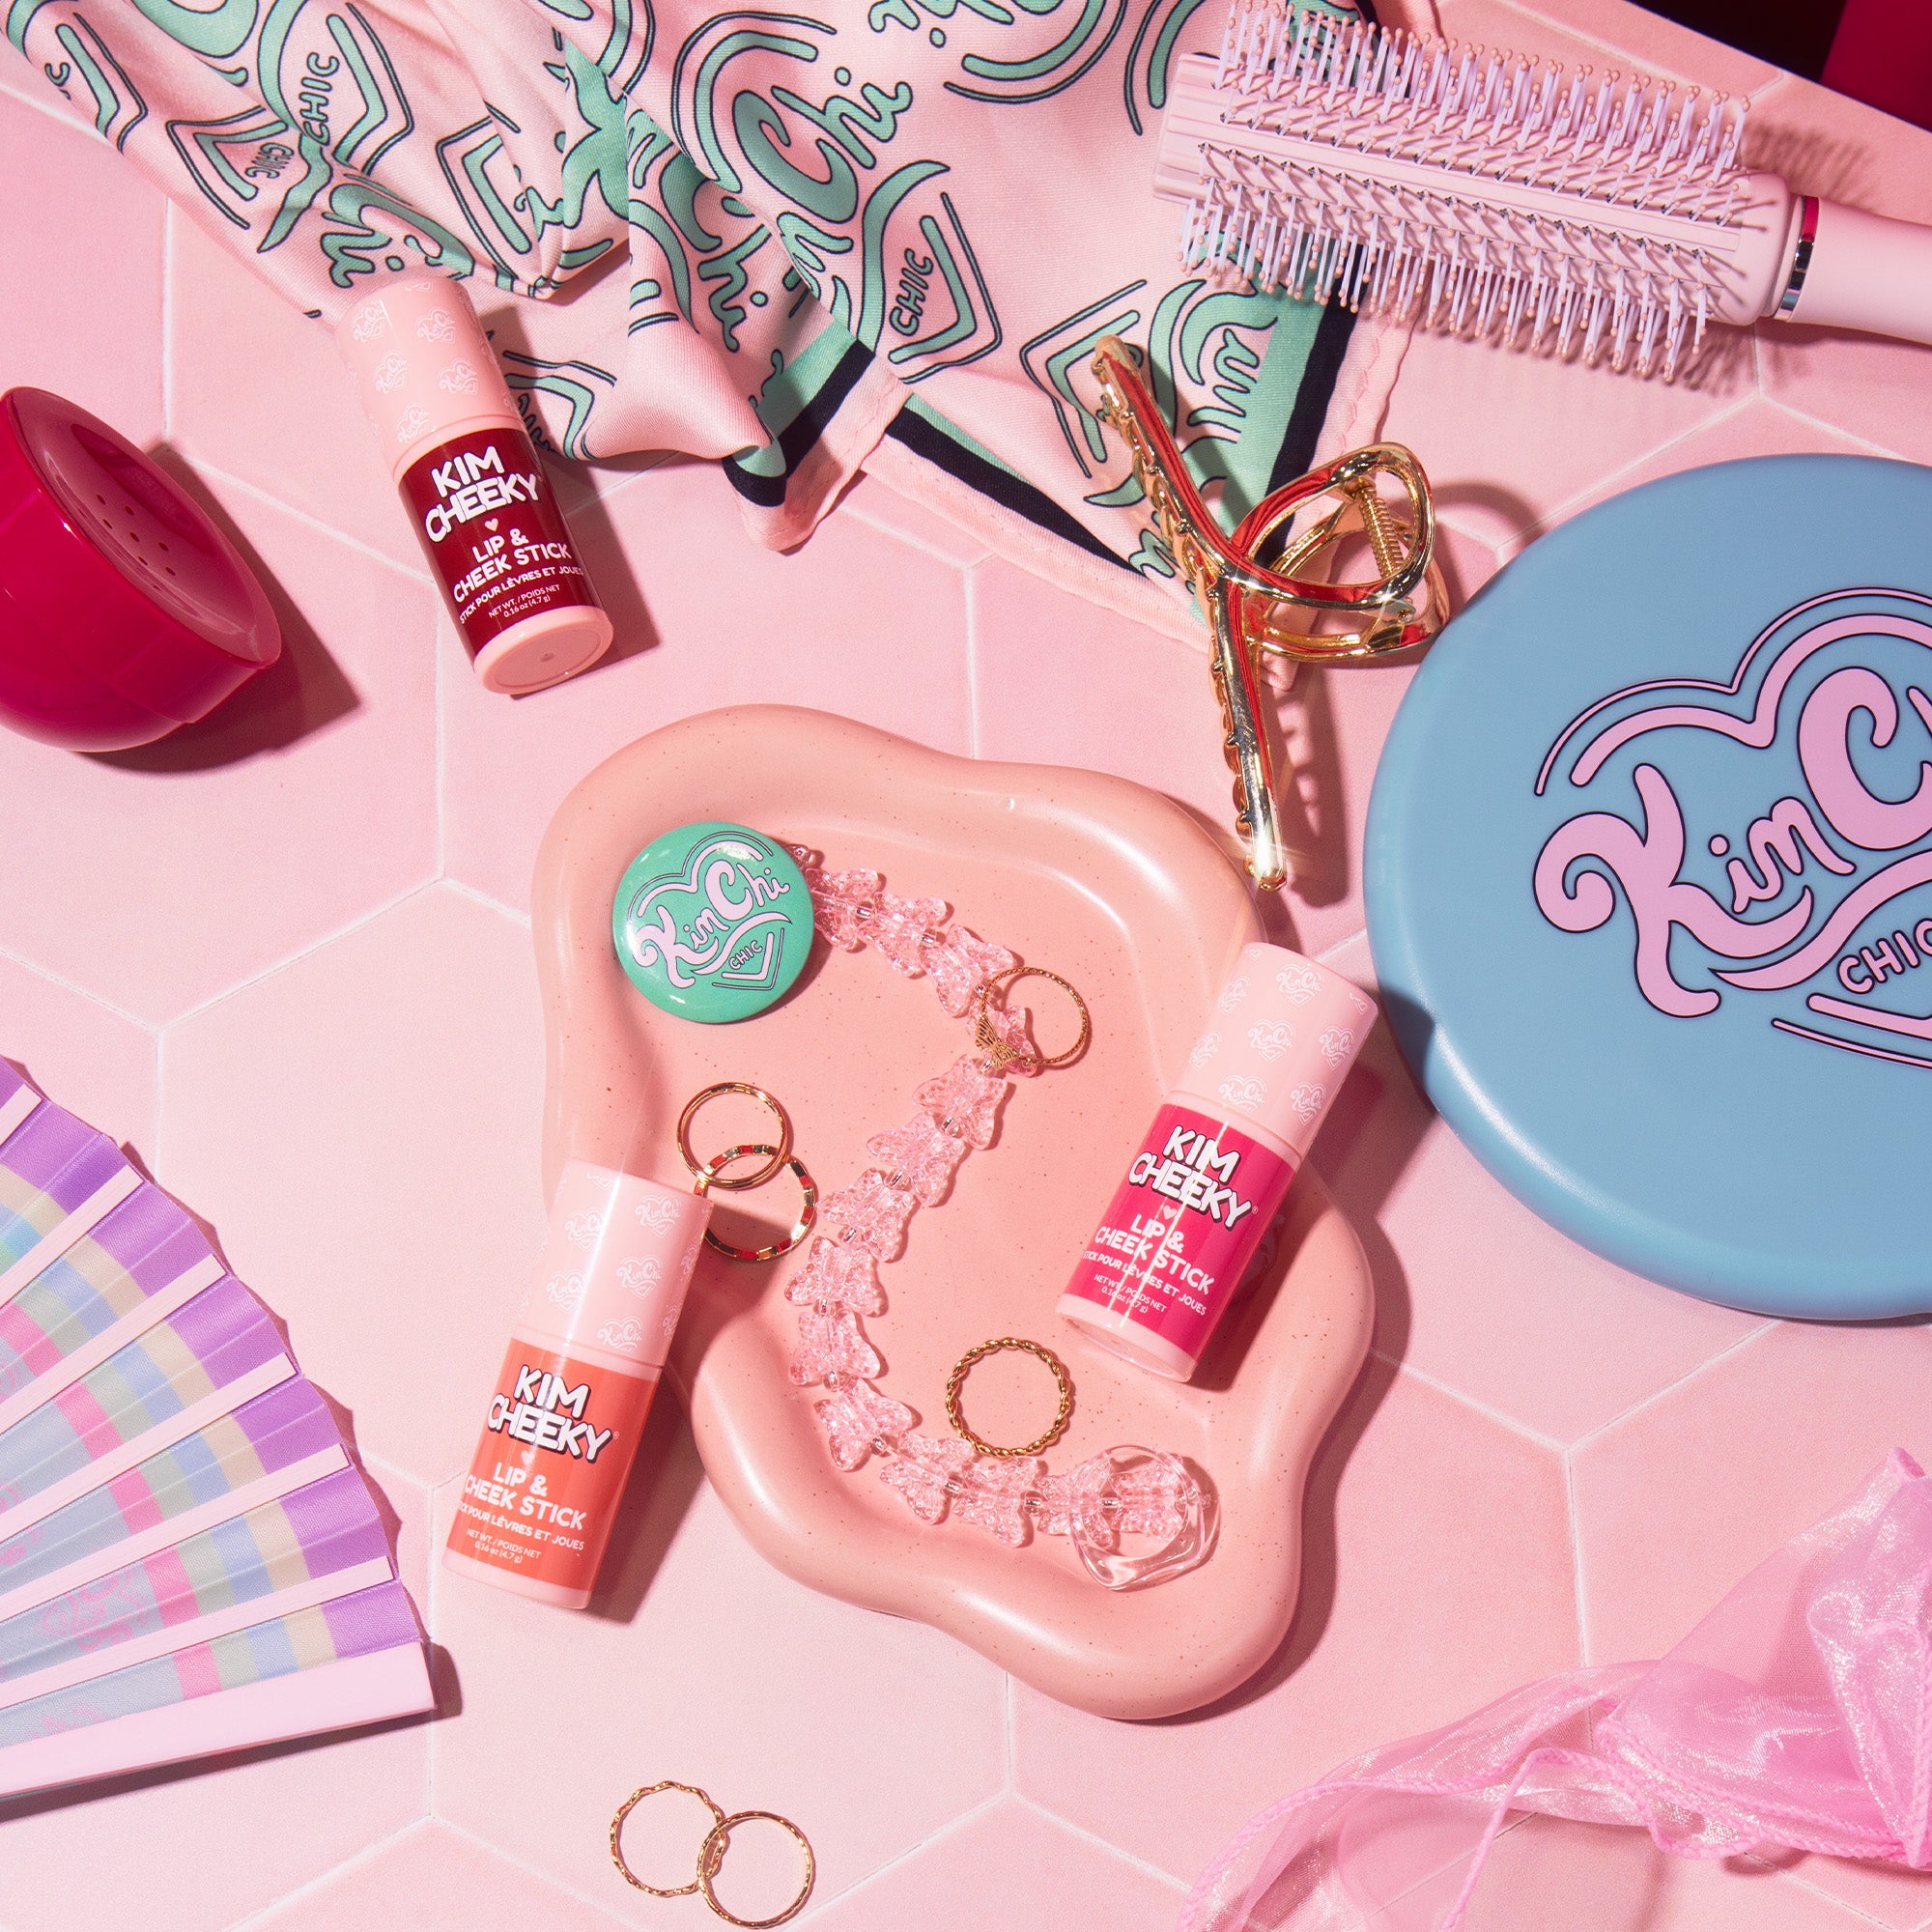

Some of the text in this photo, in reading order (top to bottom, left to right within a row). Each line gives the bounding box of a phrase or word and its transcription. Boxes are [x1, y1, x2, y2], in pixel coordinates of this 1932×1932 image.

[889, 248, 934, 336] CHIC
[431, 445, 506, 498] KIM
[425, 472, 541, 543] CHEEKY
[471, 527, 529, 563] LIP &
[453, 542, 573, 604] CHEEK STICK
[459, 602, 477, 624] STICK
[475, 586, 501, 608] POUR
[500, 569, 542, 591] LÈVRES
[542, 566, 555, 577] ET
[488, 606, 503, 619] NET
[502, 598, 518, 610] WT.
[521, 587, 546, 601] POIDS
[546, 583, 560, 593] NET
[503, 607, 520, 618] 0.16
[728, 939, 763, 970] CHIC
[1162, 1124, 1241, 1185] KIM
[1128, 1151, 1252, 1231] CHEEKY
[1094, 1225, 1215, 1295] CHEEK STICK
[1130, 1213, 1185, 1253] LIP &
[1094, 1273, 1108, 1285] NET
[1125, 1287, 1151, 1304] POIDS
[1151, 1299, 1167, 1313] NET
[1097, 1254, 1122, 1270] POUR
[1122, 1263, 1164, 1290] LÈVRES
[1162, 1283, 1179, 1297] ET
[1179, 1293, 1208, 1317] JOUES
[513, 1364, 592, 1421] KIM
[488, 1393, 613, 1464] CHEEKY
[465, 1474, 587, 1531] CHEEK STICK
[493, 1462, 548, 1497] LIP &
[467, 1528, 480, 1538] NET
[479, 1531, 493, 1545] WT.
[497, 1539, 525, 1554] POIDS
[524, 1547, 542, 1559] NET
[469, 1506, 491, 1522] POUR
[491, 1515, 533, 1537] LÈVRES
[534, 1528, 552, 1542] ET
[552, 1534, 585, 1551] JOUES
[498, 1549, 514, 1561] (4.7
